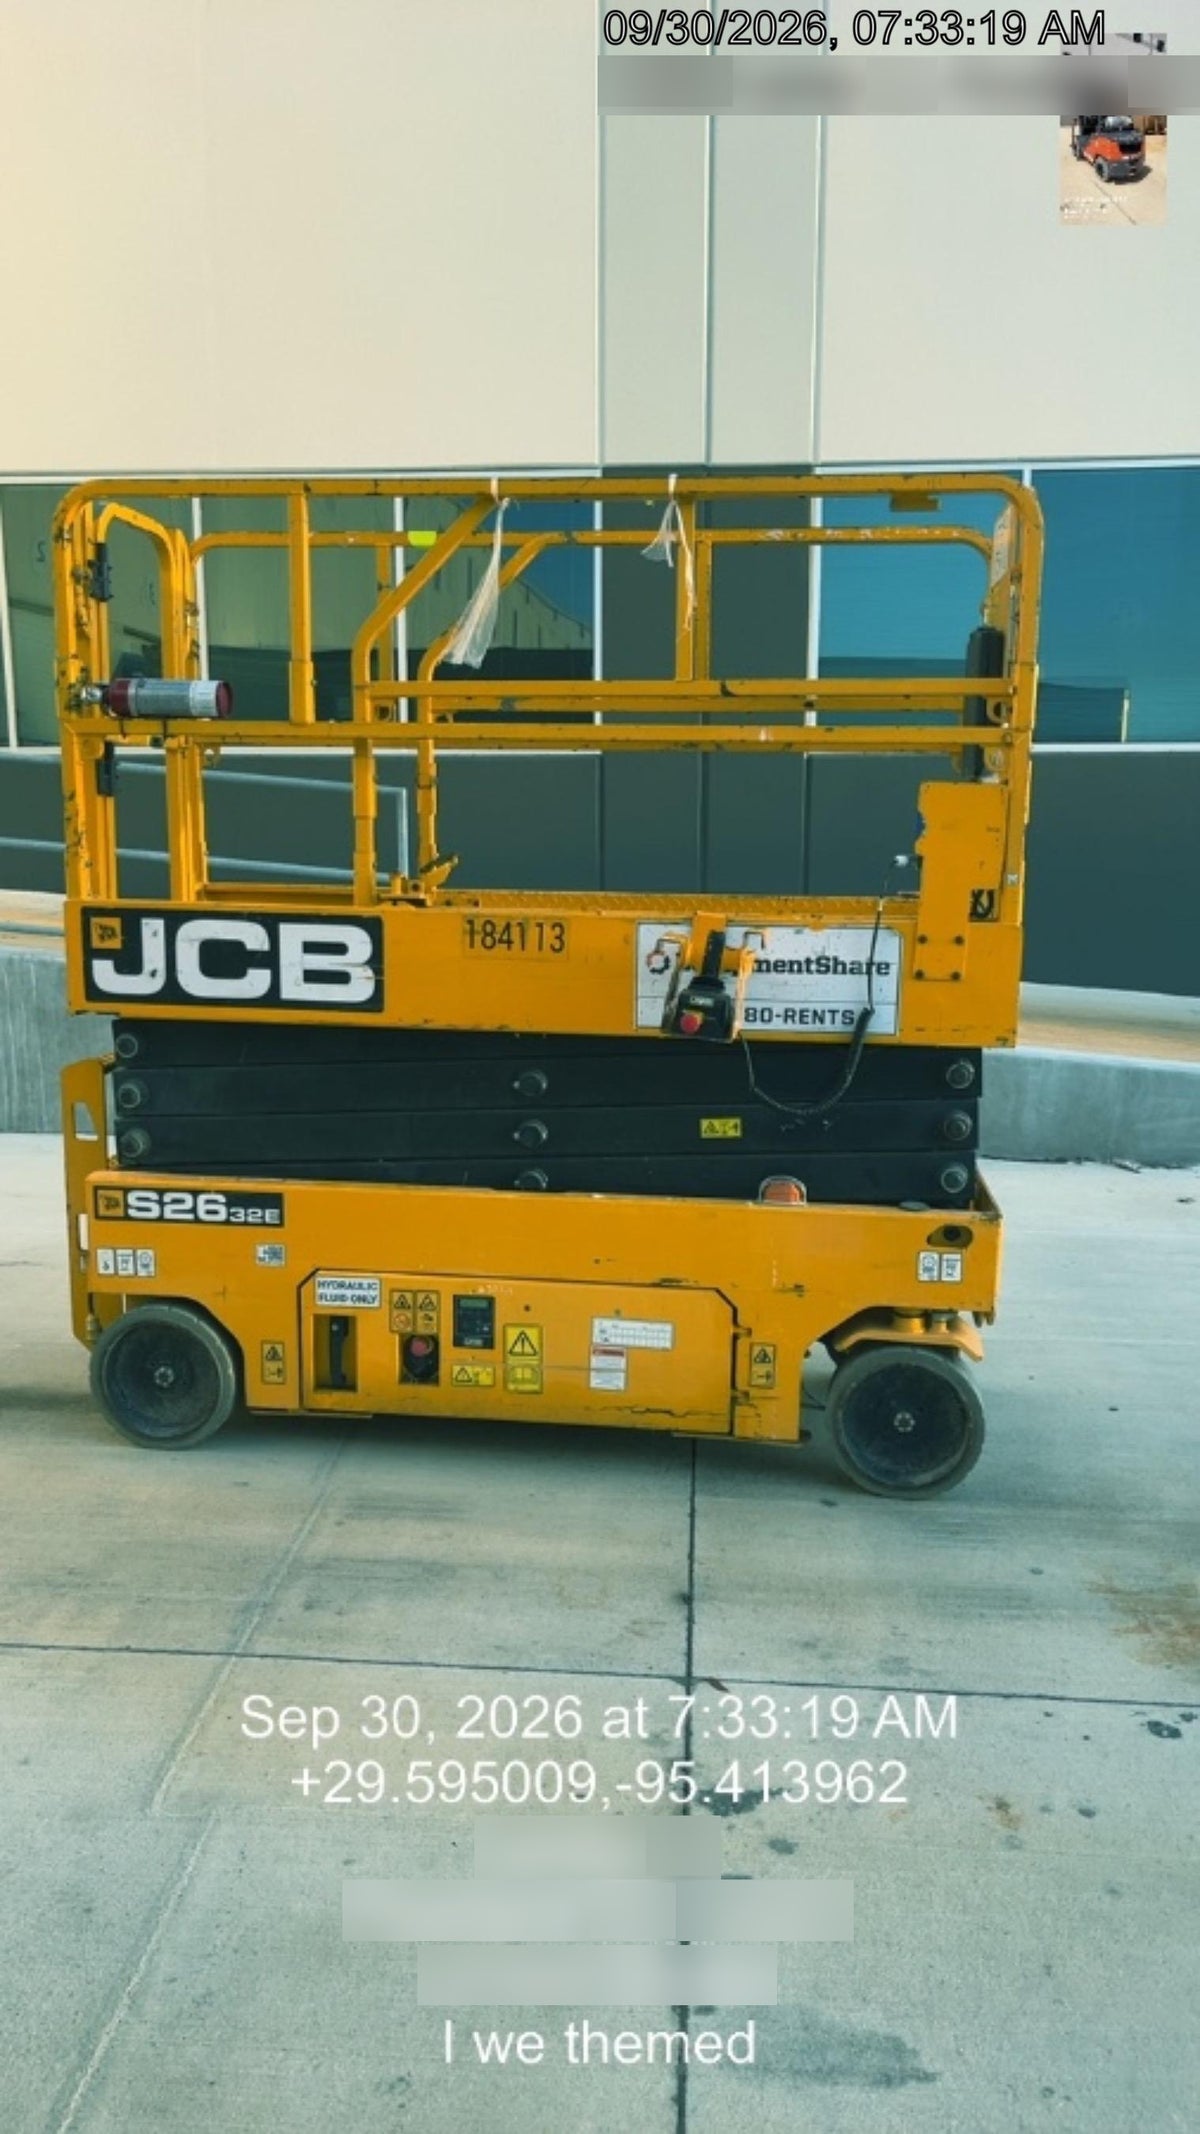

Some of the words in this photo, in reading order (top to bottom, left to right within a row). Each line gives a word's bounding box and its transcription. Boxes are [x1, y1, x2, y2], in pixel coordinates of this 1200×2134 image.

[466, 919, 566, 953] 184113
[92, 918, 376, 1004] JCB
[752, 955, 891, 976] mentShare
[127, 1190, 228, 1222] S26
